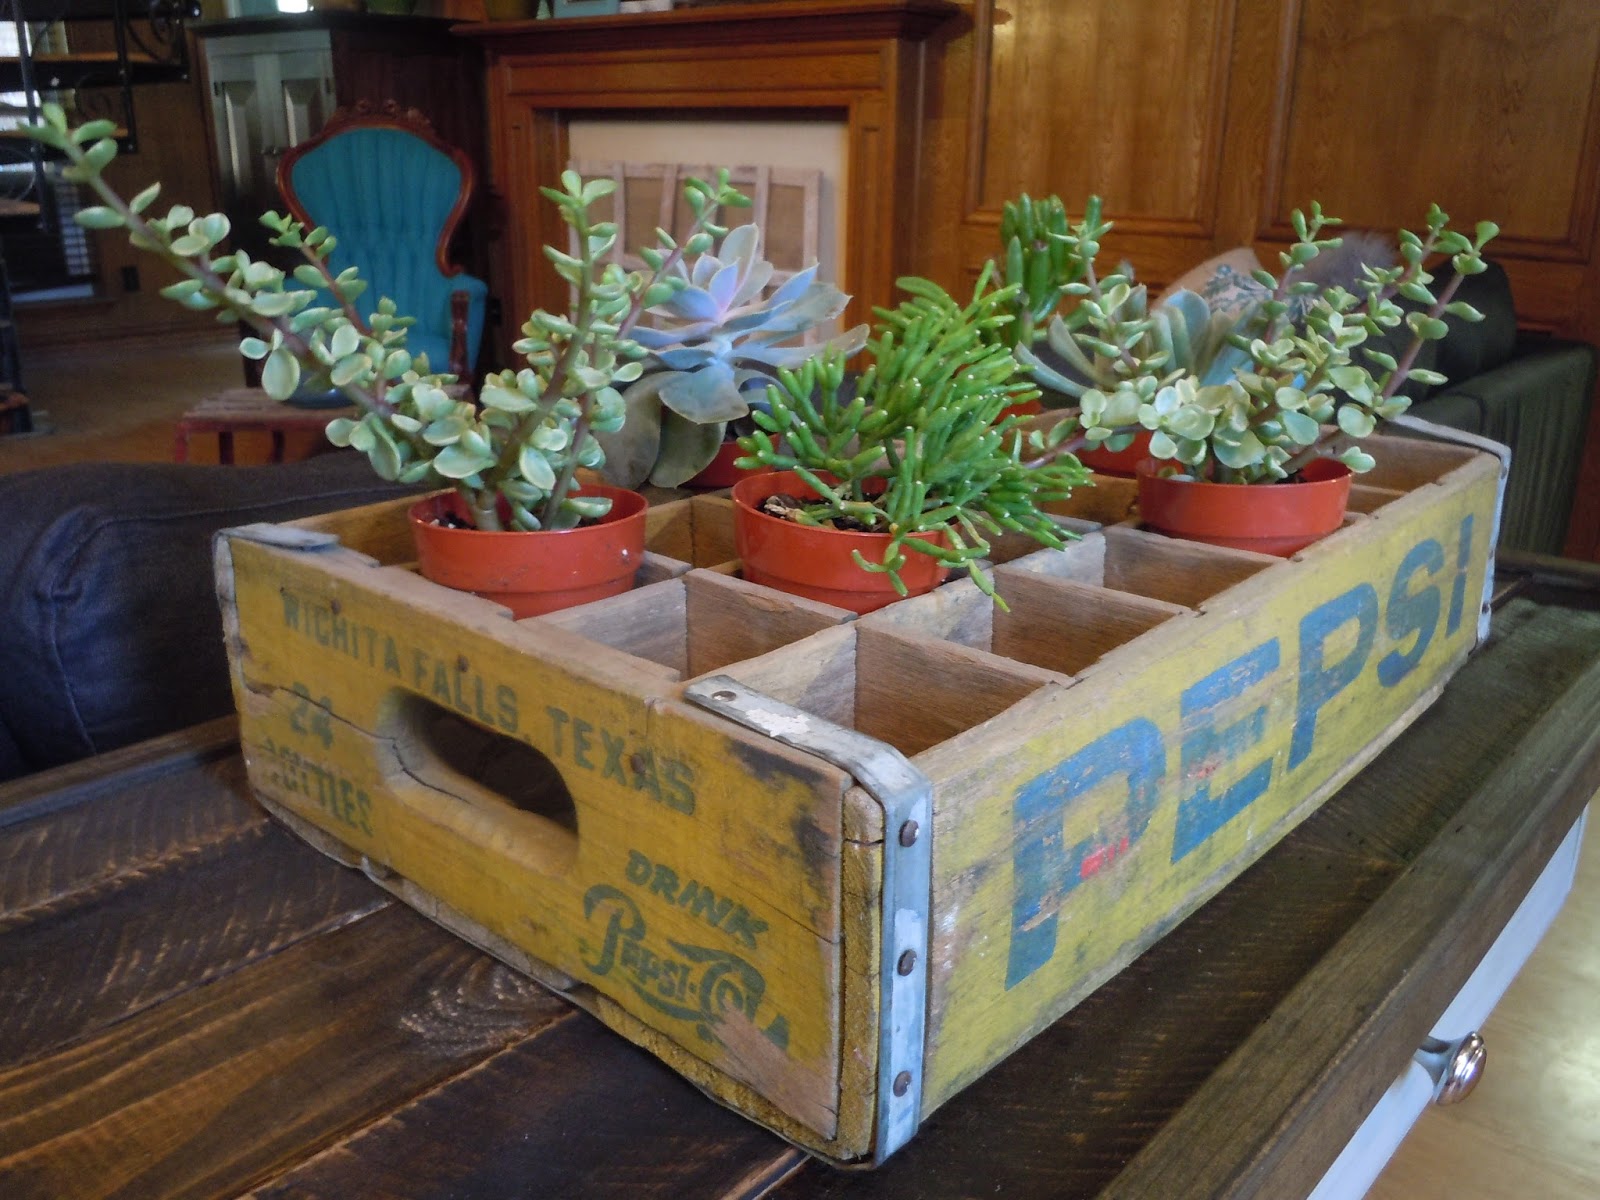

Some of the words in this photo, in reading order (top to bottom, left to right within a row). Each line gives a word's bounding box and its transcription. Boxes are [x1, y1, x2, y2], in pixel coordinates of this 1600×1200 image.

[282, 590, 402, 678] WICHITA
[412, 646, 519, 733] FALLS
[546, 705, 697, 817] TEXAS
[289, 681, 335, 751] 24
[1004, 513, 1474, 992] PEPSI
[261, 739, 375, 839] OTTLES
[624, 849, 770, 950] DRINK
